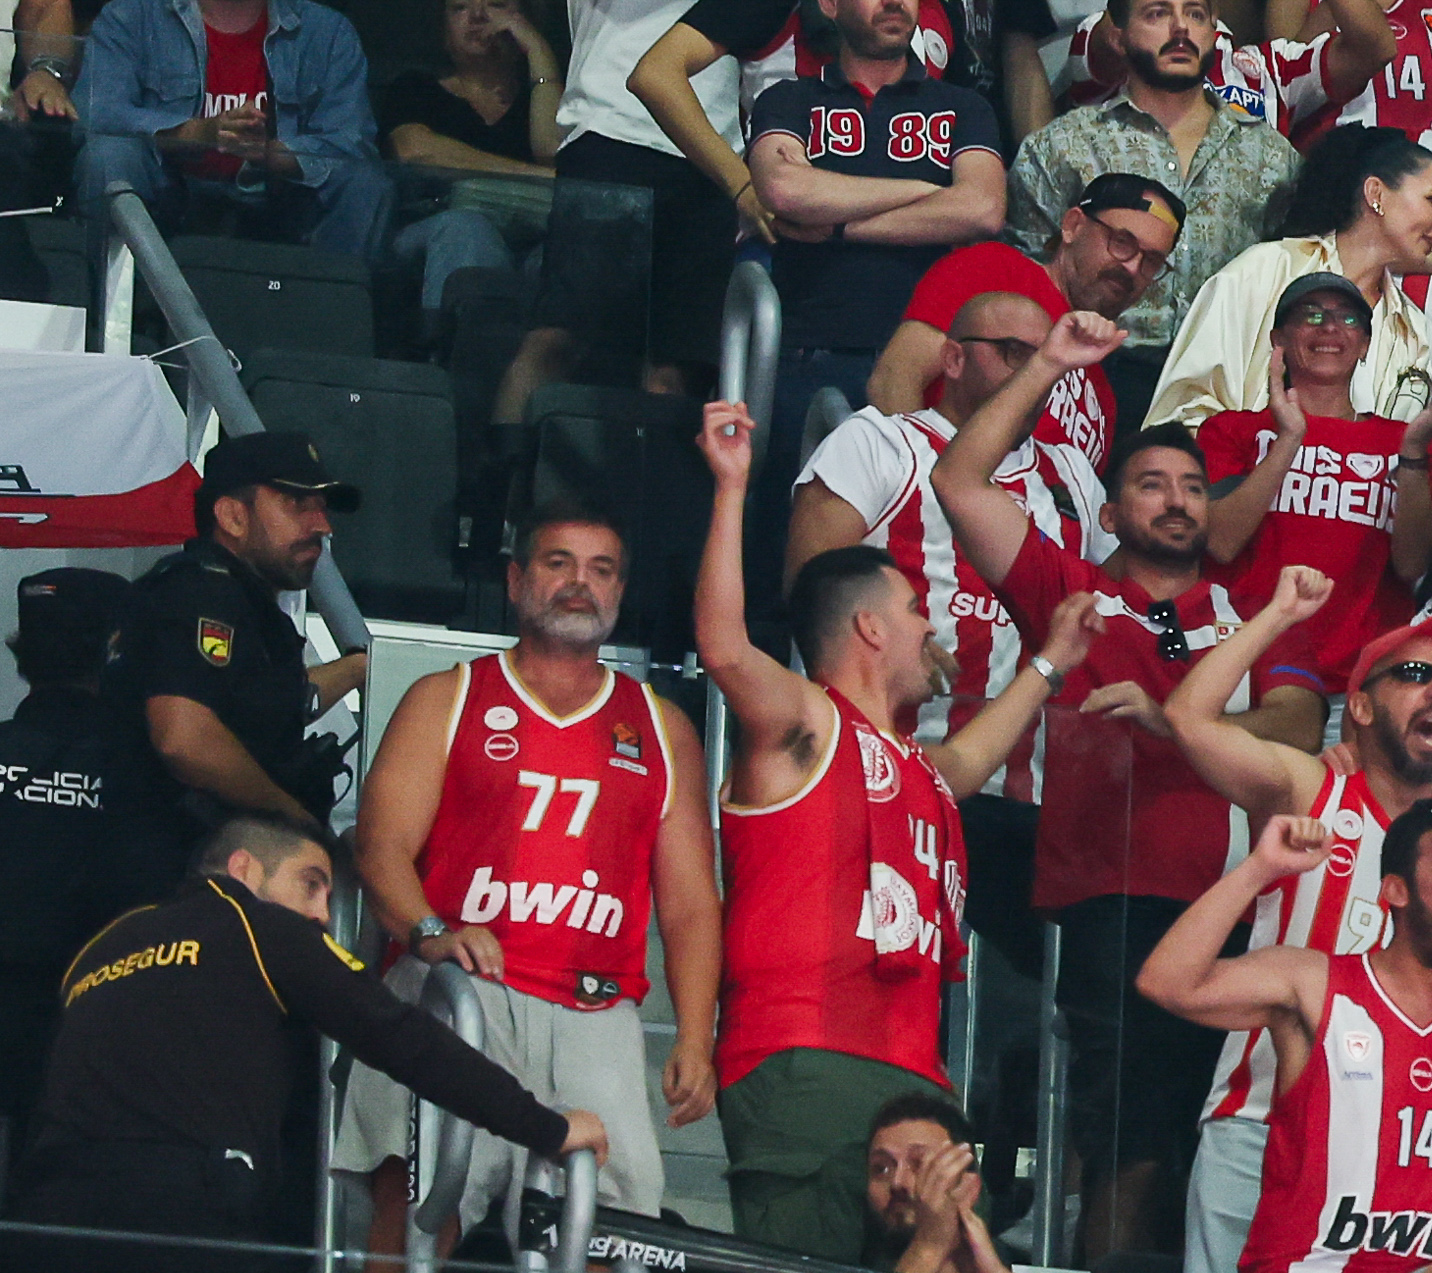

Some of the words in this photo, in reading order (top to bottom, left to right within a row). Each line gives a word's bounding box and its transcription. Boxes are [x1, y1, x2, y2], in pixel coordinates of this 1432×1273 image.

[1384, 54, 1426, 101] 14
[807, 105, 867, 162] 19
[887, 111, 958, 170] 89
[268, 279, 282, 291] 20
[1255, 428, 1342, 475] TIS
[518, 770, 601, 839] 77
[460, 865, 624, 939] bwin
[610, 1235, 688, 1273] ARENA
